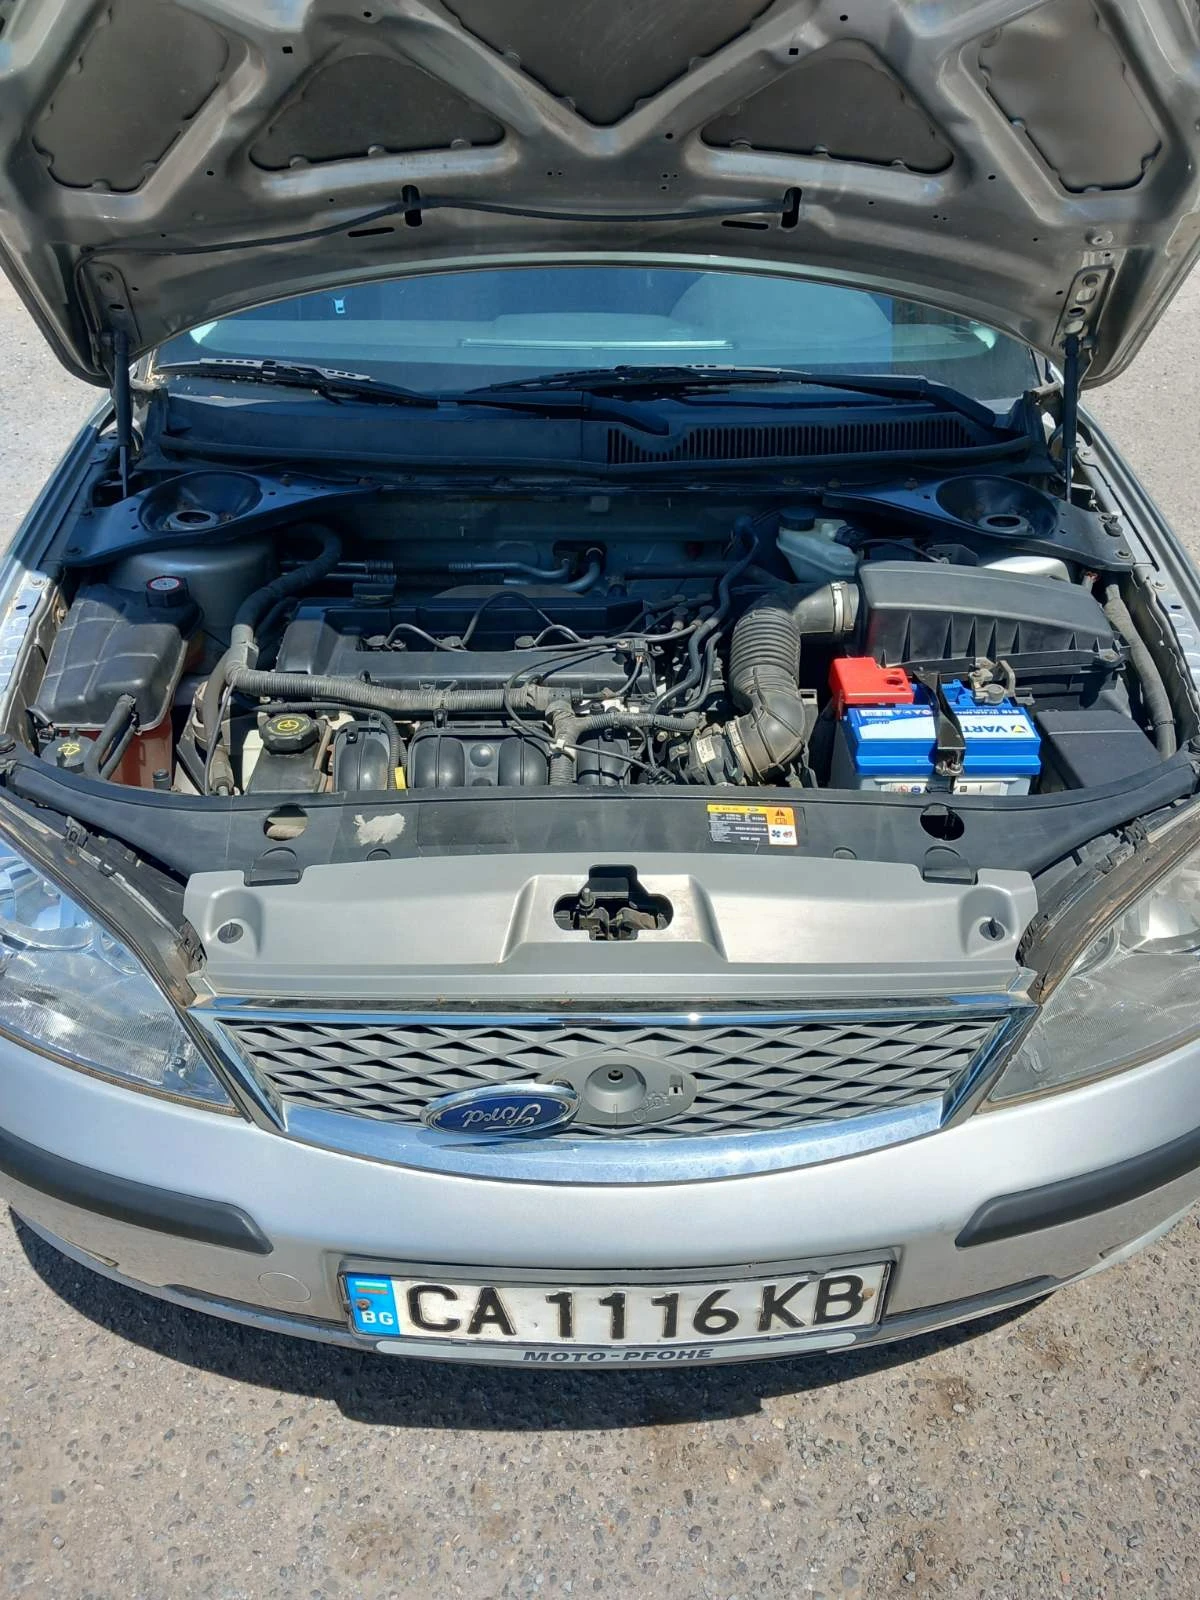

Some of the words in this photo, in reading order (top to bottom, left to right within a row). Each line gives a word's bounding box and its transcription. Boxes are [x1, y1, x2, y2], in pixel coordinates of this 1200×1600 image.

[962, 725, 1008, 733] VART
[462, 1103, 541, 1130] Ford
[406, 1285, 517, 1336] CA
[545, 1289, 739, 1339] 1116
[758, 1275, 863, 1332] KB
[361, 1311, 394, 1326] BG
